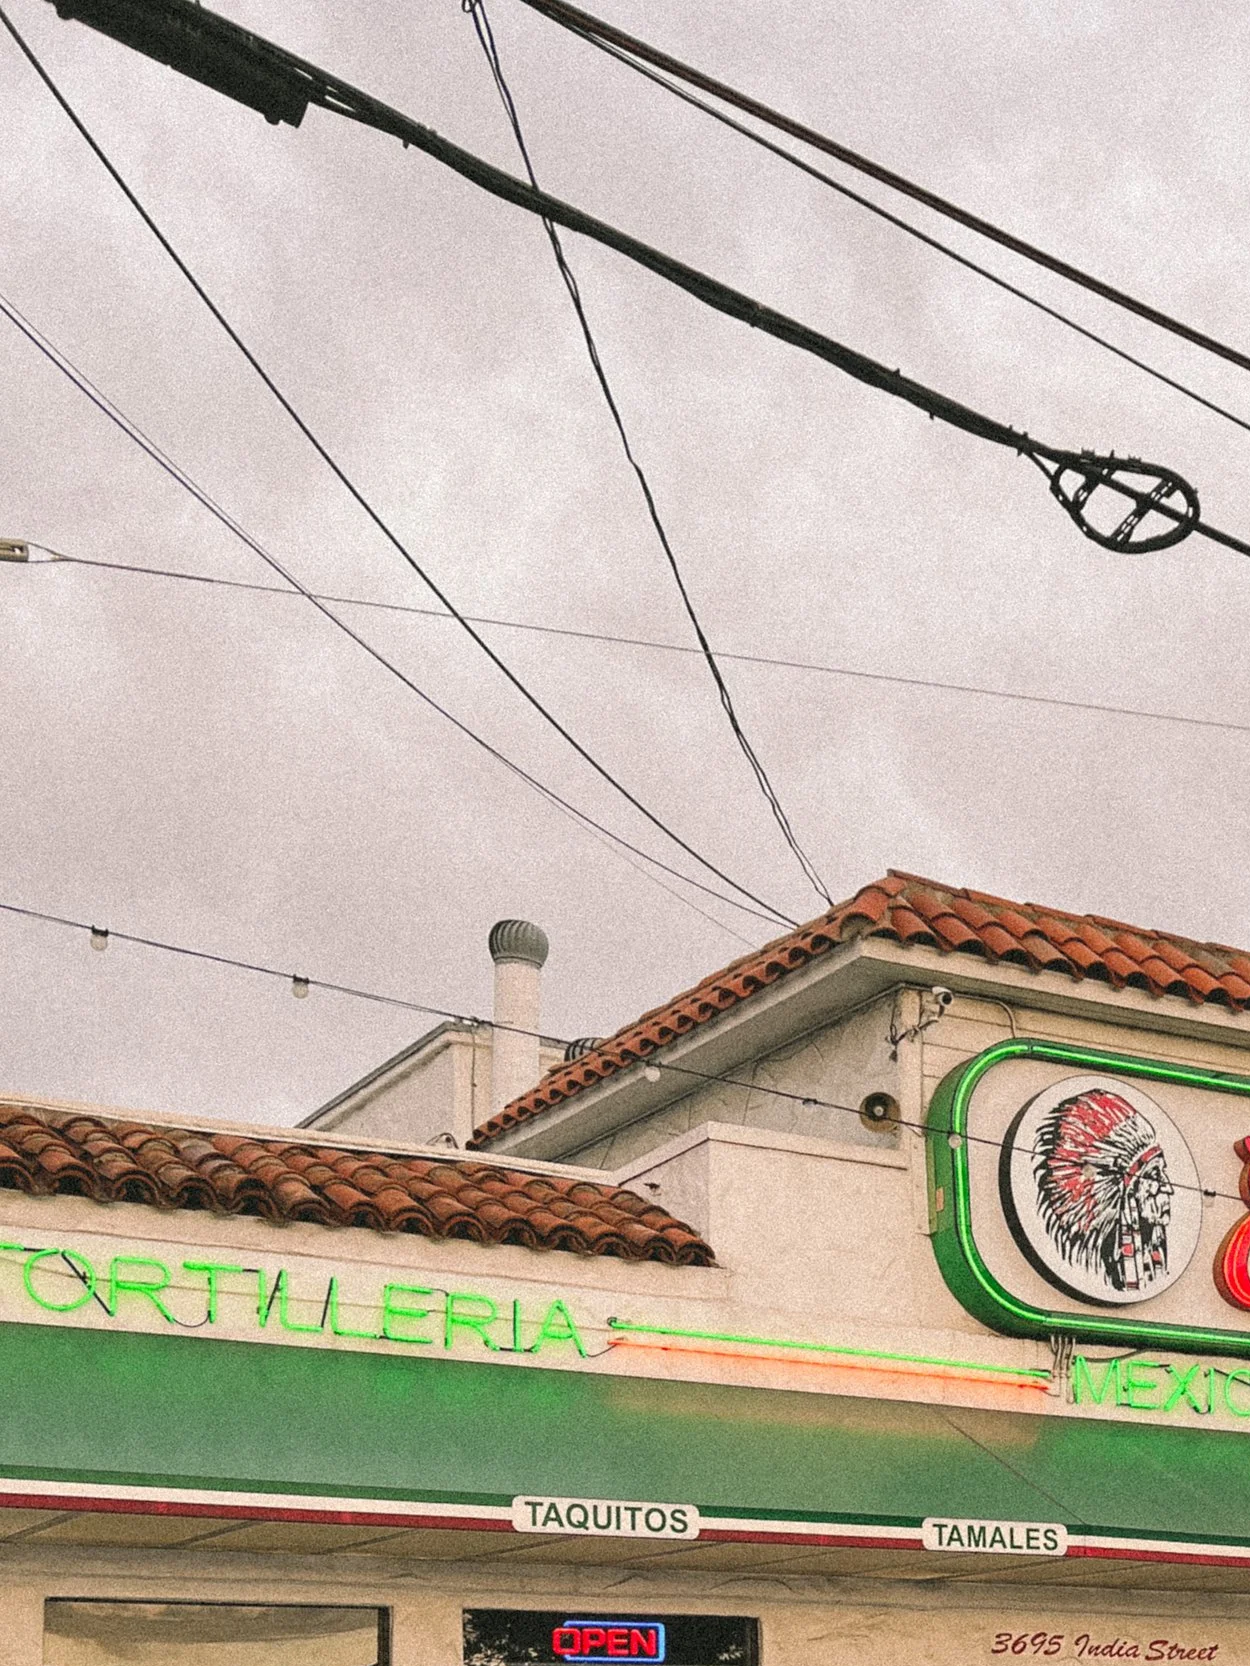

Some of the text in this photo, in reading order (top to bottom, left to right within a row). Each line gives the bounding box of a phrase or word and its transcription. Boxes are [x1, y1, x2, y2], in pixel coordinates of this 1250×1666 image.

[0, 1242, 588, 1358] ORTILLERIA
[524, 1501, 689, 1533] TAQUITOS
[932, 1523, 1059, 1551] TAMALES
[552, 1627, 657, 1656] OPEN
[991, 1632, 1219, 1661] 3695 India Street
